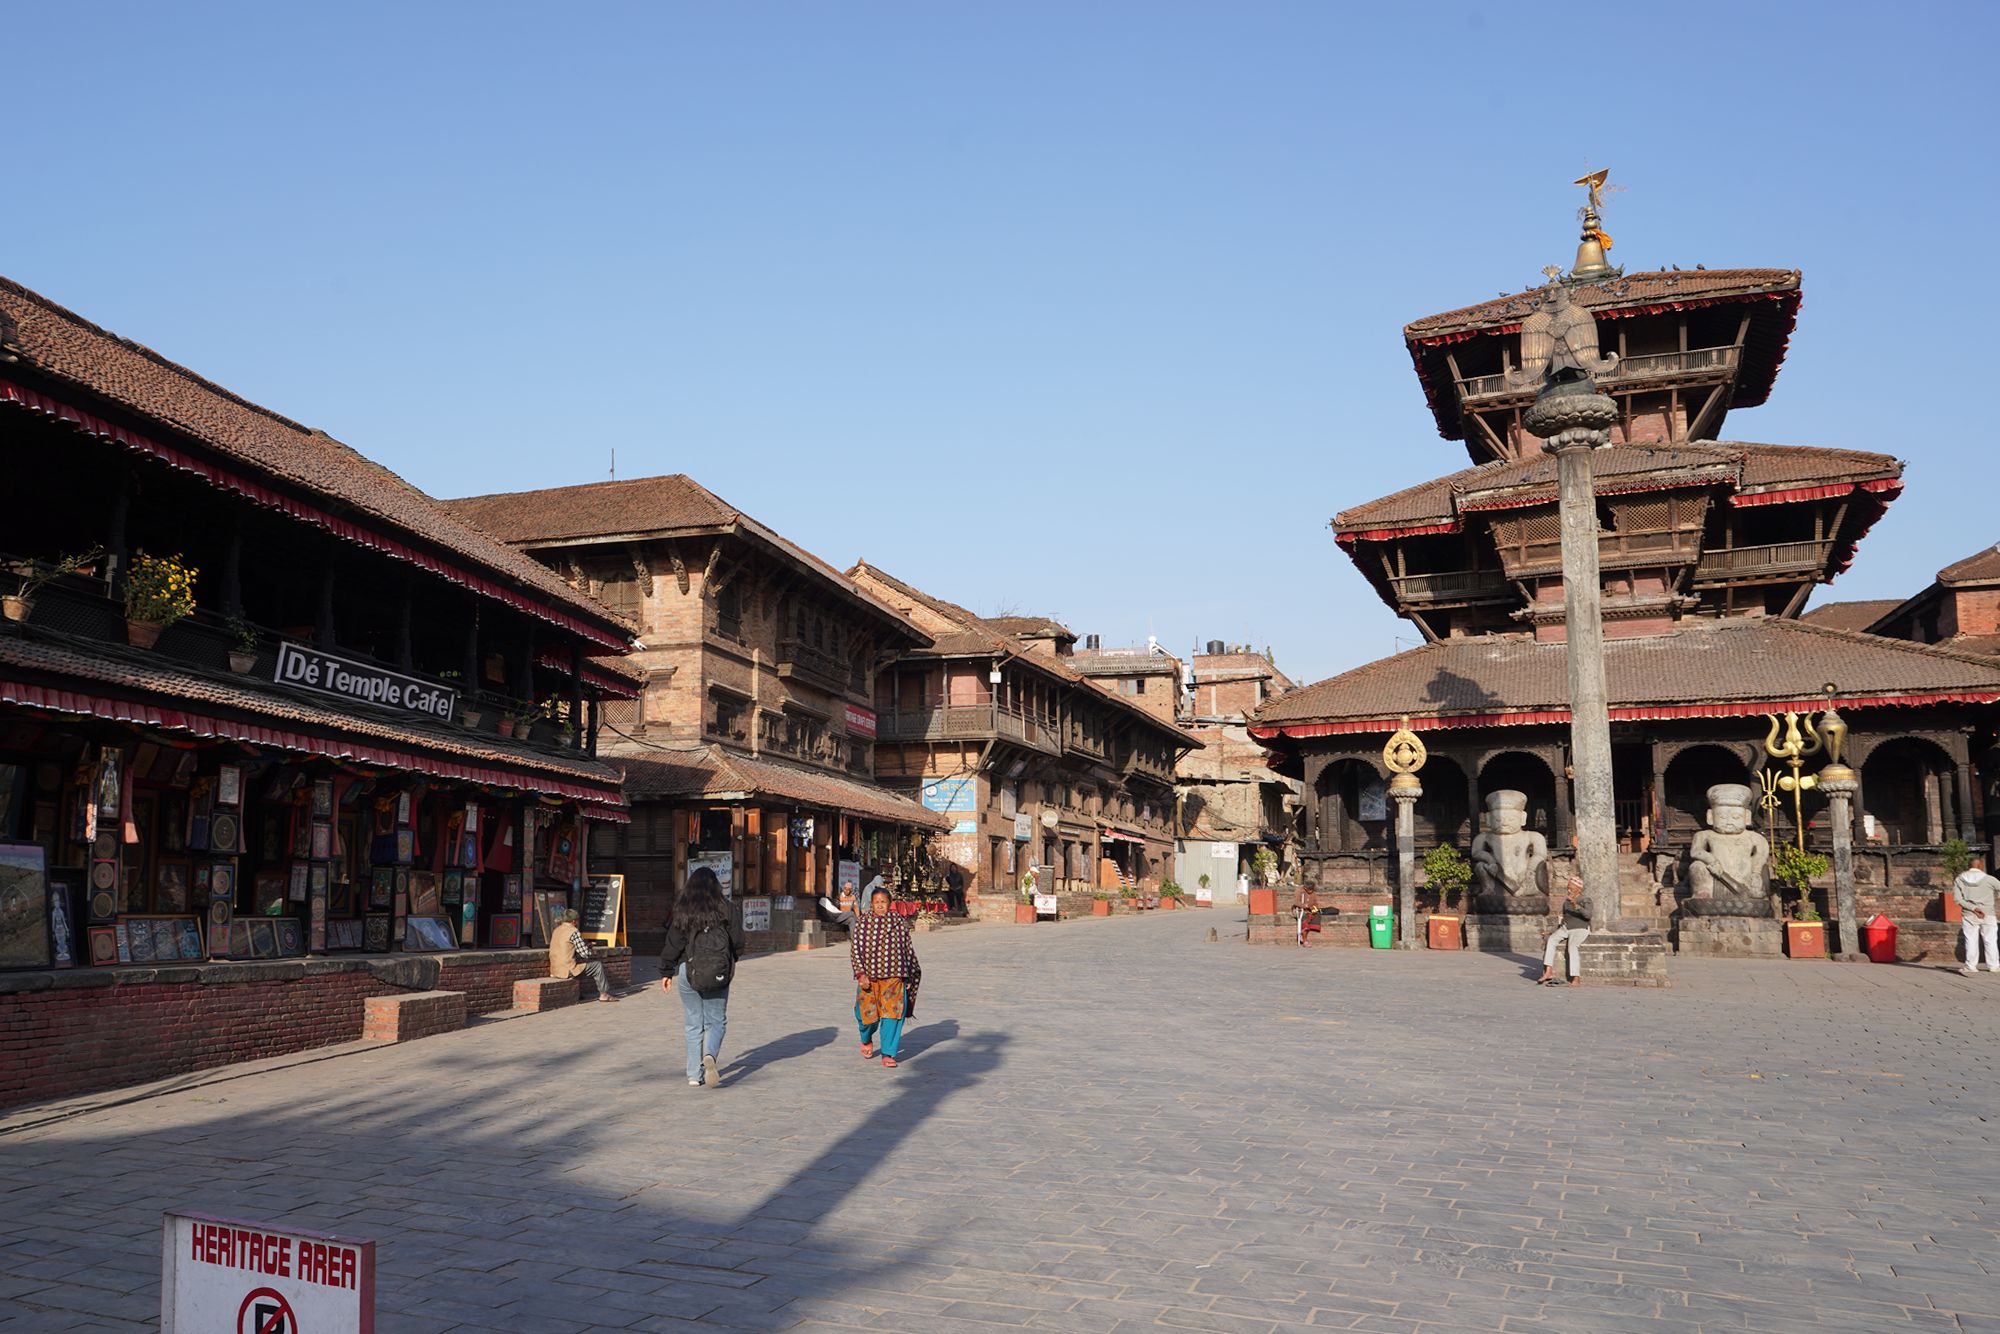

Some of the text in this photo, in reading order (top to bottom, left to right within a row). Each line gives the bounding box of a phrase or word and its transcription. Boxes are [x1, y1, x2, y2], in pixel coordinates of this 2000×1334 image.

[285, 651, 449, 716] Dé Temple Cafe
[191, 1222, 356, 1291] HERITAGE AREA
